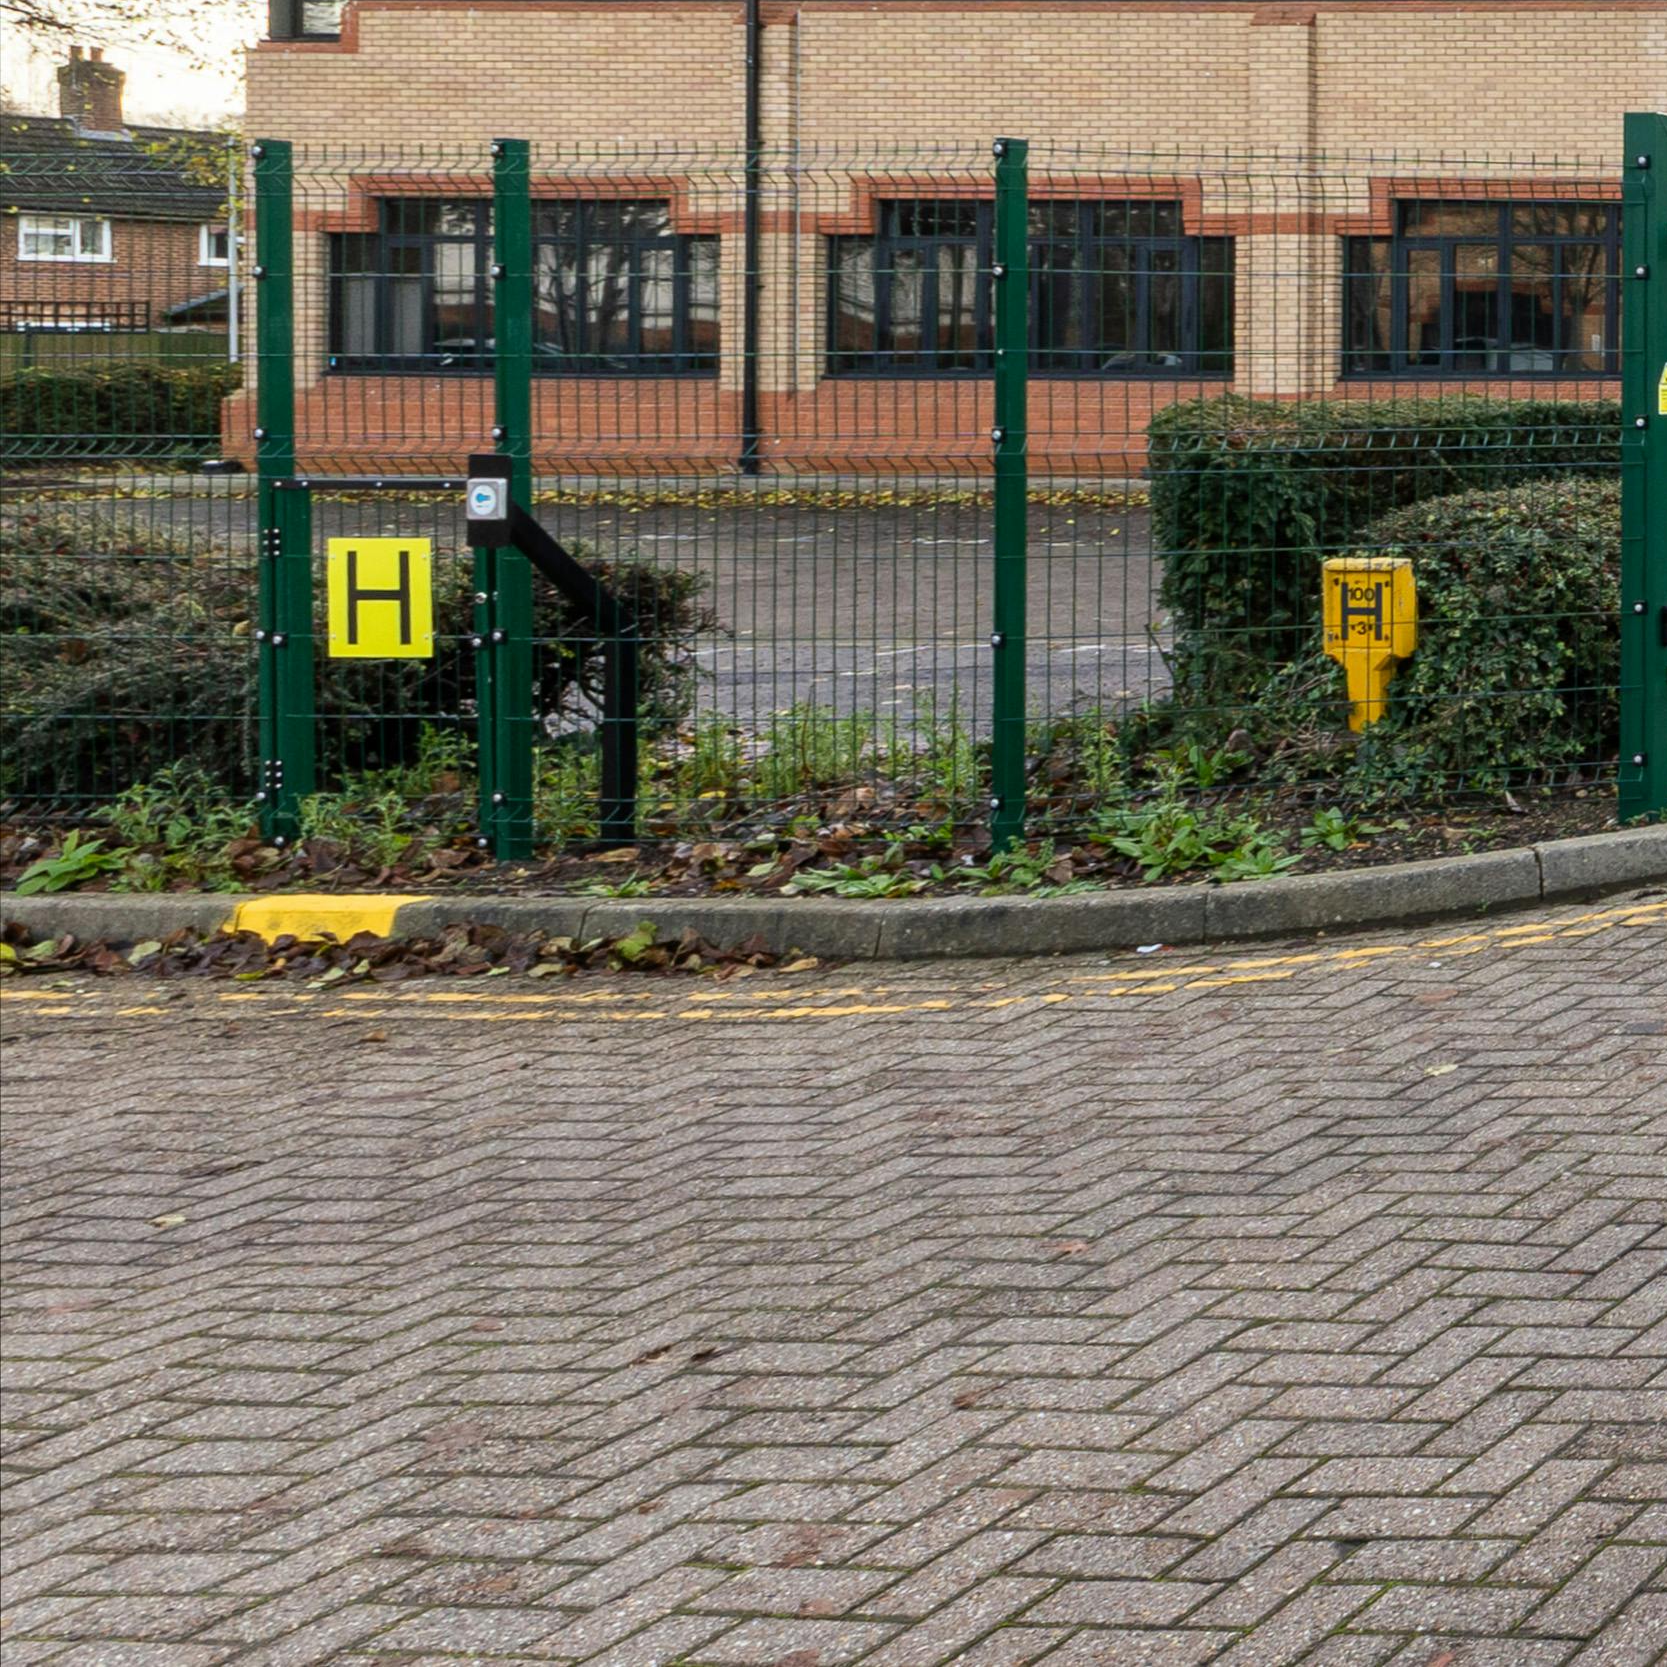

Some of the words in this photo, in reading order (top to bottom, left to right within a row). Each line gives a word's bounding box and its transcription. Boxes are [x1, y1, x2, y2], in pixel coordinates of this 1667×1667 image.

[347, 550, 411, 645] H
[1341, 582, 1383, 641] H
[1348, 587, 1375, 602] 100
